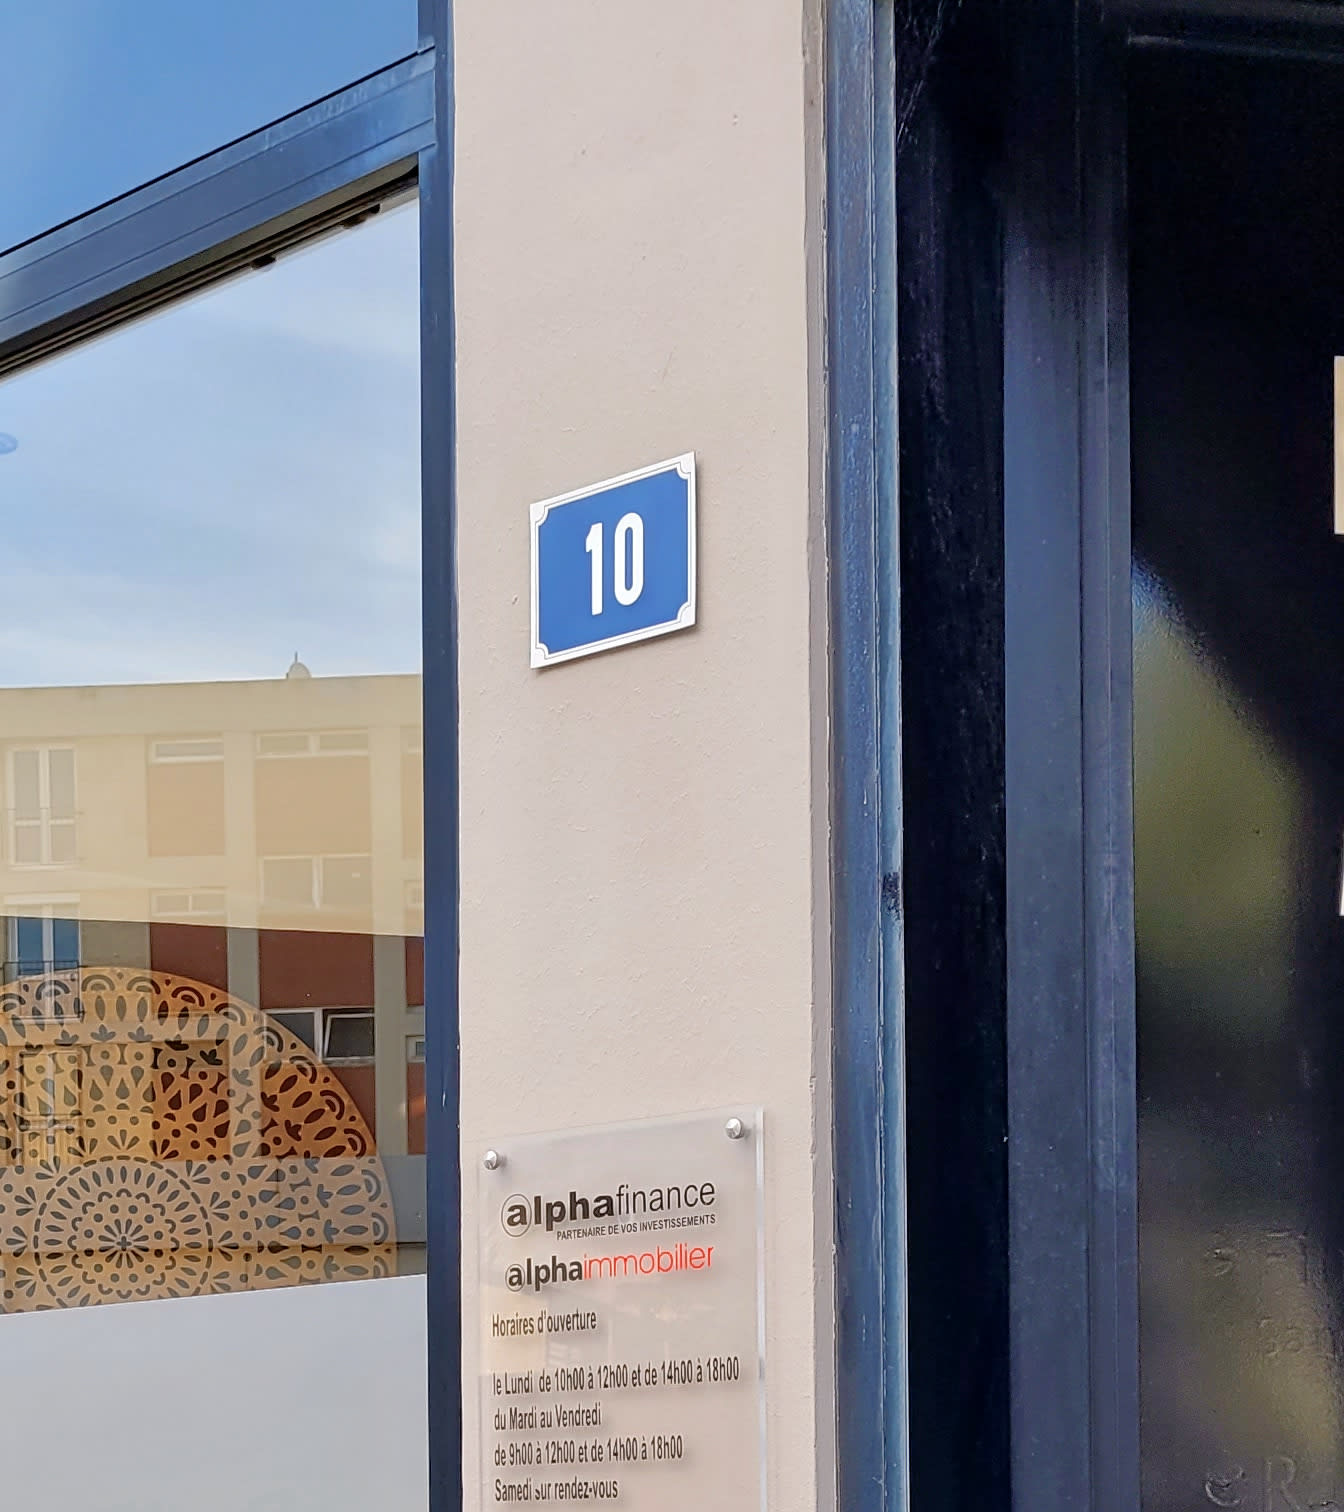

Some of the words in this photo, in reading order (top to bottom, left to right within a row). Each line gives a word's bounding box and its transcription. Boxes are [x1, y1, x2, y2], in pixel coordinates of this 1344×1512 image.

[586, 512, 643, 616] 10
[501, 1182, 715, 1237] alphafinance
[557, 1225, 606, 1240] PARTENAIRE
[608, 1225, 619, 1235] DE
[622, 1223, 638, 1233] VOS
[640, 1214, 715, 1231] INVESTISSEMENTS
[505, 1242, 714, 1292] alphaimmobilier
[493, 1313, 534, 1337] Horaires
[493, 1373, 502, 1395] le
[505, 1370, 533, 1395] Lundi
[539, 1369, 551, 1392] de
[555, 1367, 585, 1391] 10h00
[587, 1366, 594, 1389] à
[598, 1364, 628, 1389] 12h00
[632, 1365, 641, 1387] et
[644, 1363, 657, 1386] de
[661, 1360, 693, 1384] 14h00
[697, 1359, 703, 1382] à
[707, 1356, 739, 1382] 18h00
[494, 1409, 506, 1430] du
[509, 1406, 537, 1430] Mardi
[540, 1407, 552, 1428] au
[555, 1402, 601, 1427] Vendredi
[495, 1444, 506, 1466] de
[509, 1442, 532, 1465] 9h00
[536, 1443, 542, 1464] à
[546, 1441, 575, 1464] 12h00
[579, 1443, 588, 1463] et
[591, 1440, 603, 1462] de
[607, 1438, 637, 1461] 14h00
[641, 1437, 647, 1460] à
[651, 1435, 683, 1459] 18h00
[495, 1478, 532, 1501] Samedi
[535, 1483, 551, 1500] sur
[555, 1476, 618, 1500] rendez-vous
